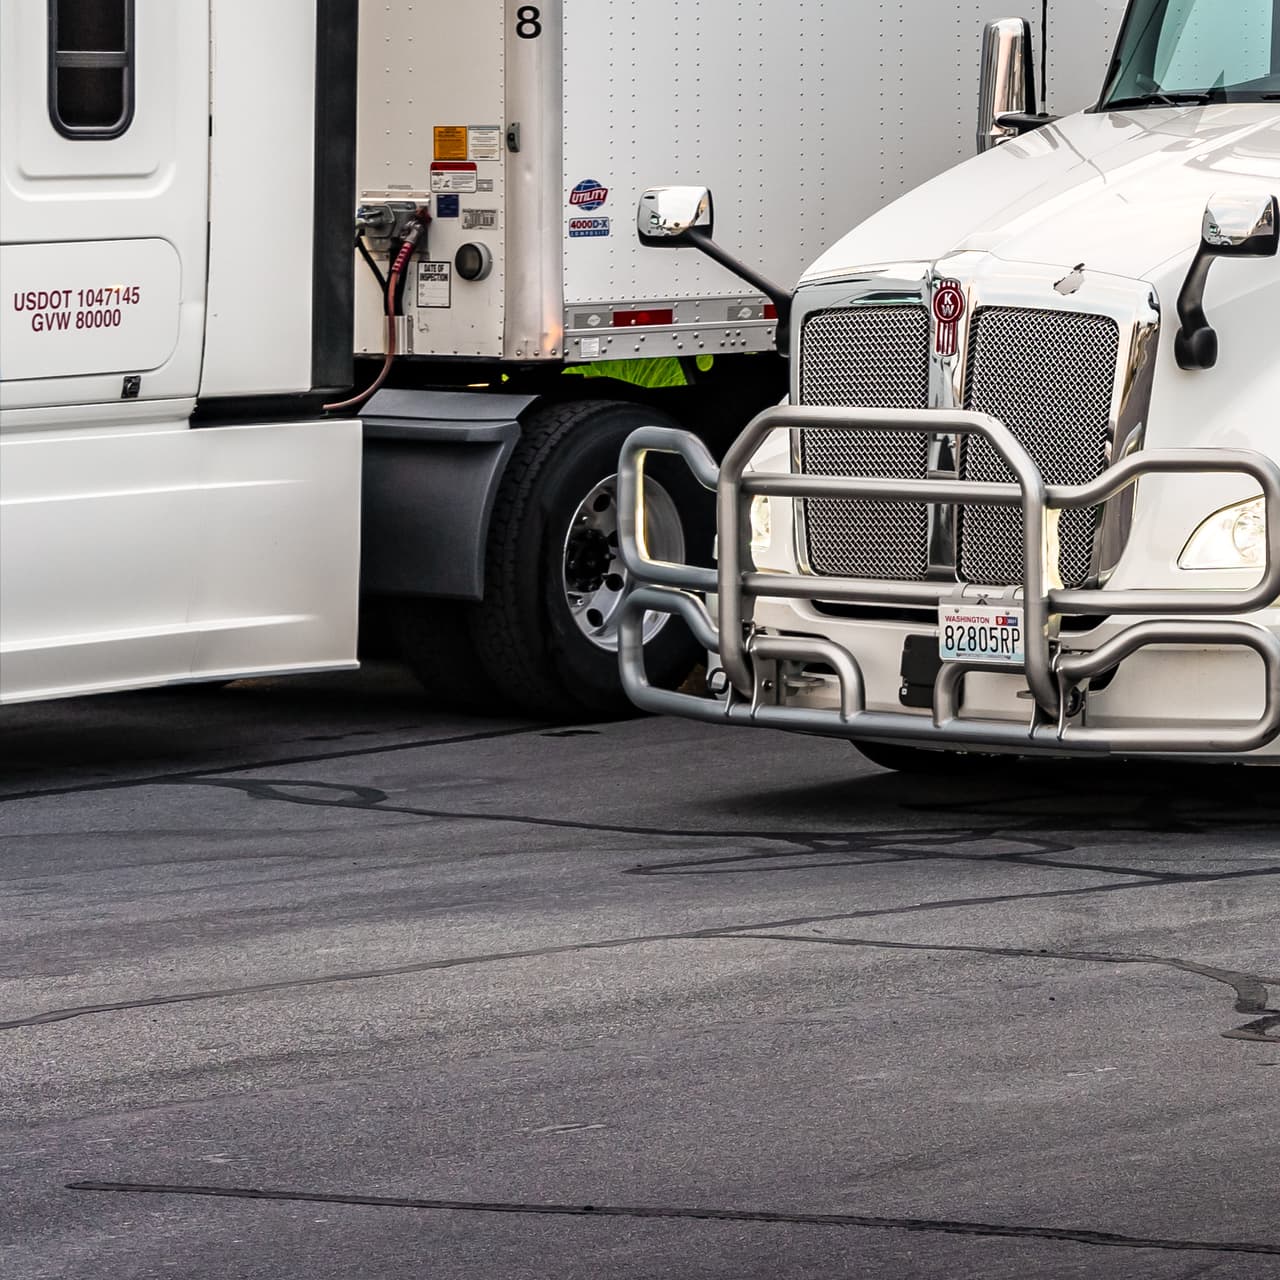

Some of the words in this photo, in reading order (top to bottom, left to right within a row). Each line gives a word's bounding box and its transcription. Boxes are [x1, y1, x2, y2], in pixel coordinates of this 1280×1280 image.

[571, 189, 607, 203] UTILITY
[13, 289, 73, 312] USDOT
[77, 286, 140, 308] 1047145
[31, 311, 72, 332] GVW
[75, 308, 122, 329] 80000
[944, 615, 990, 624] WASHINGTON
[944, 624, 1020, 654] 82805RP
